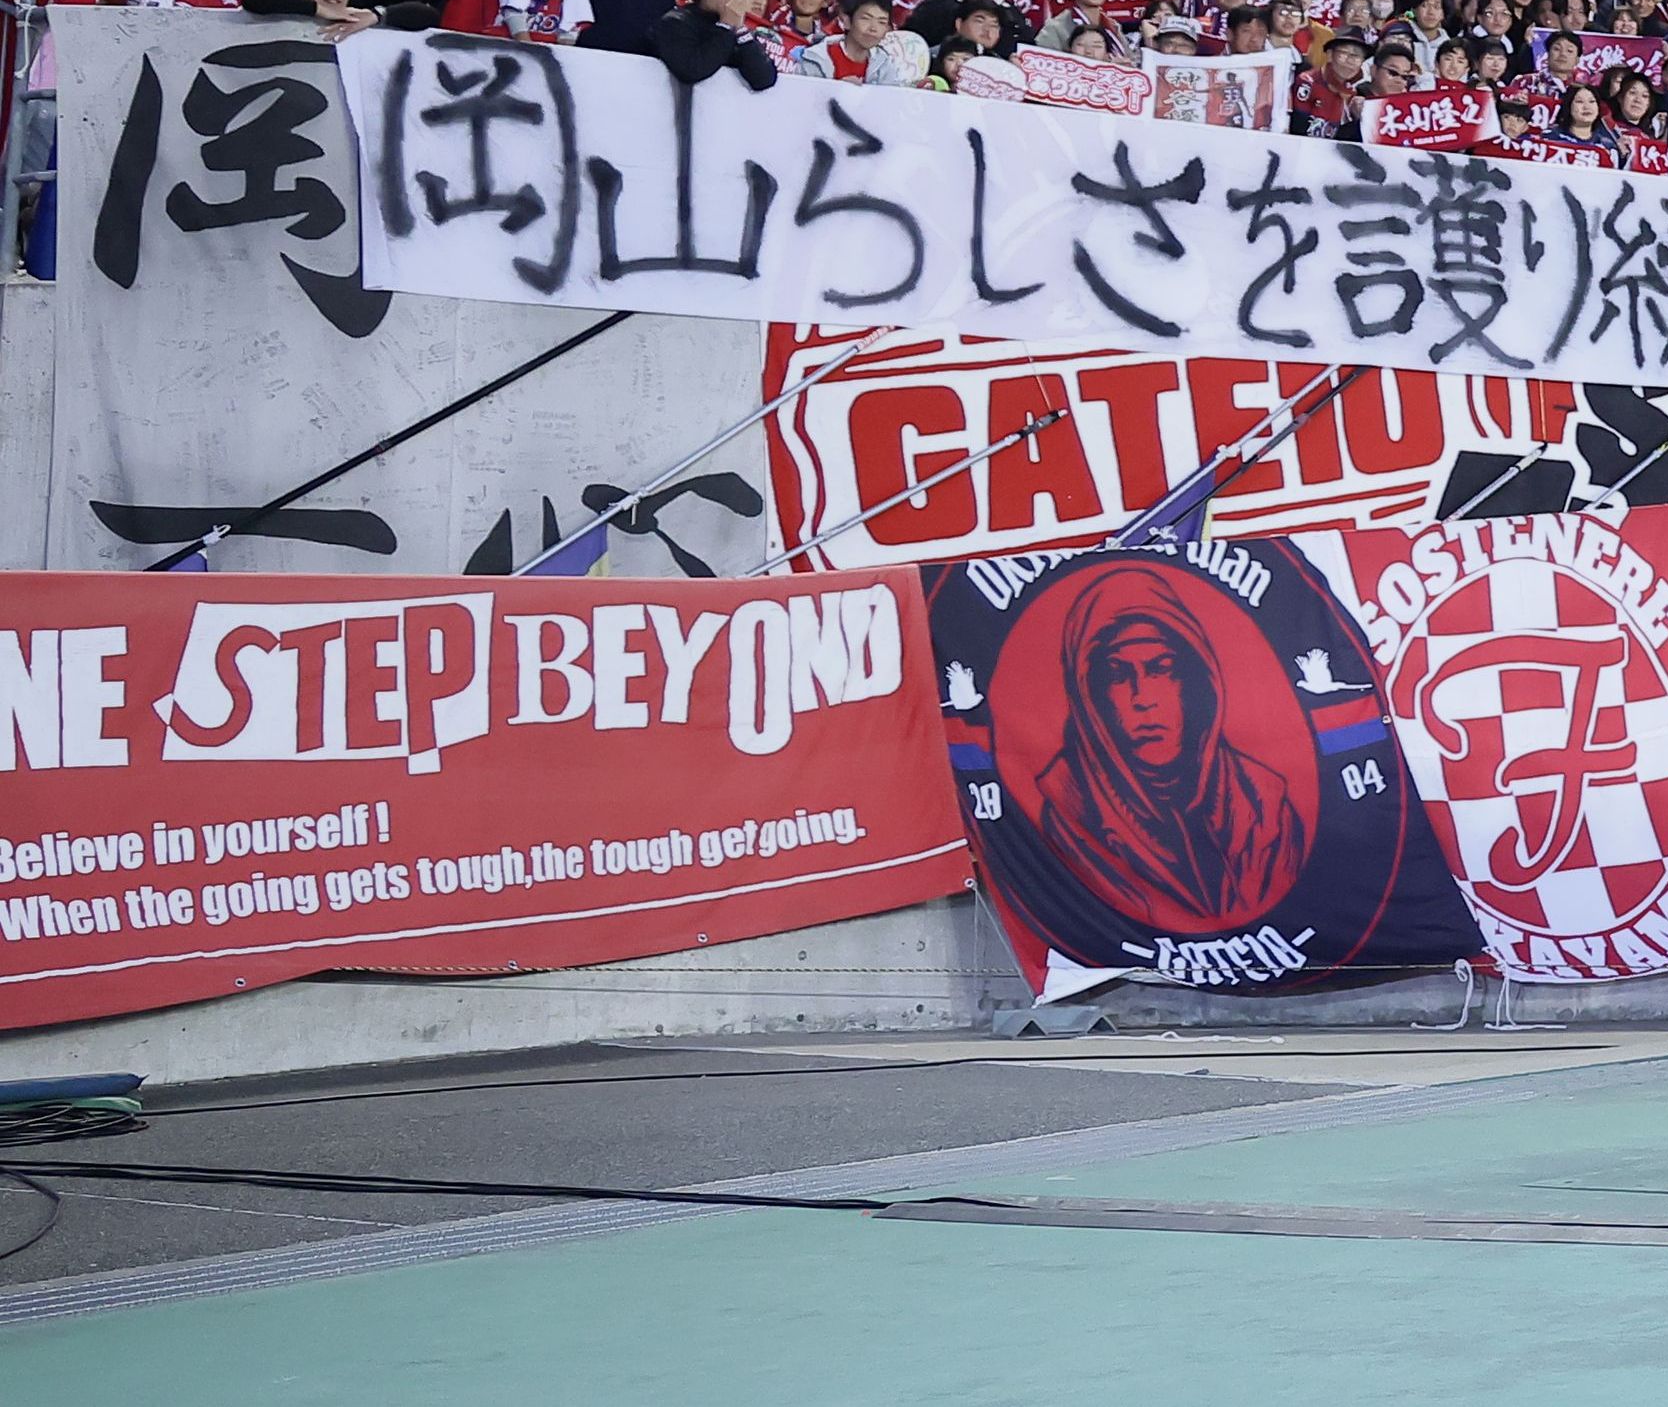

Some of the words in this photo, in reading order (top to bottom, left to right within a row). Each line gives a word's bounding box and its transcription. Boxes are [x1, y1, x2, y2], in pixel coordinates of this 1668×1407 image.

[168, 595, 476, 758] STEP
[503, 583, 904, 758] BEYOND
[0, 831, 144, 884] Believe
[153, 822, 195, 868] in
[0, 894, 119, 942] When
[127, 885, 195, 931] the
[203, 873, 320, 927] going
[328, 862, 409, 910] gets
[592, 829, 695, 879] tough
[758, 802, 868, 857] going.
